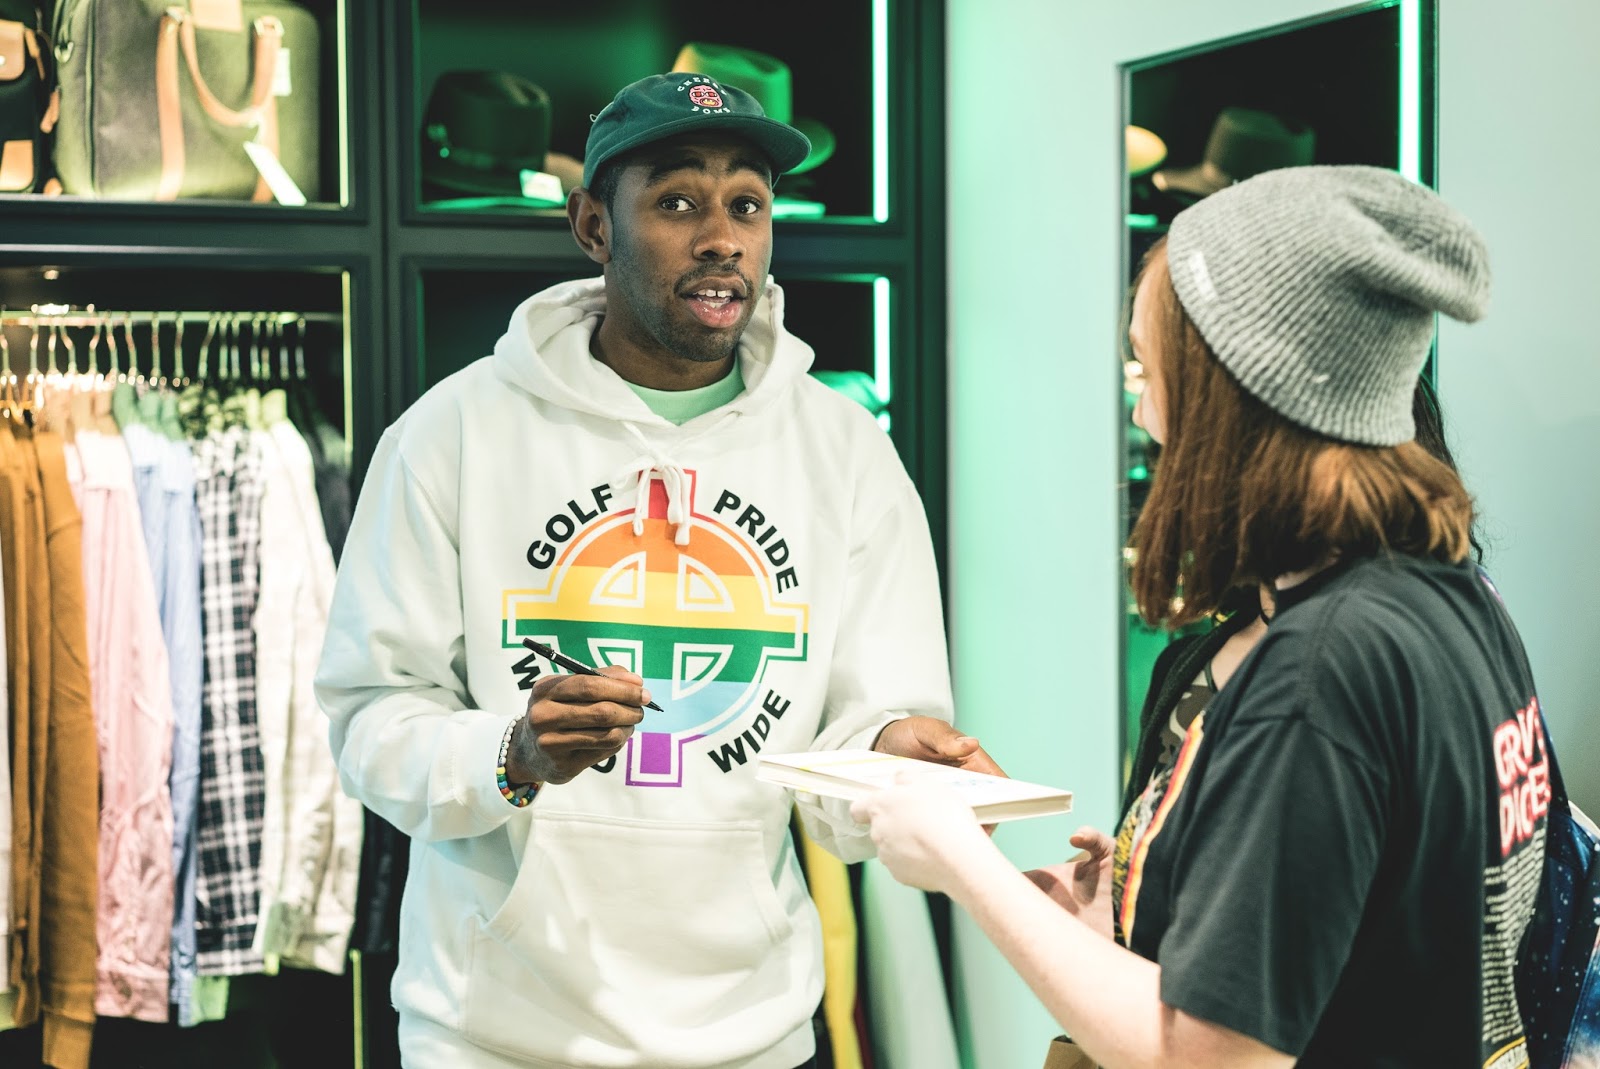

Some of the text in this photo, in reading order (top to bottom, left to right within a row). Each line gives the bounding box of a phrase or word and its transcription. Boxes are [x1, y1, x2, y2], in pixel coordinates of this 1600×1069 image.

[526, 483, 799, 594] GOLF PRIDE
[707, 689, 791, 774] WIDE
